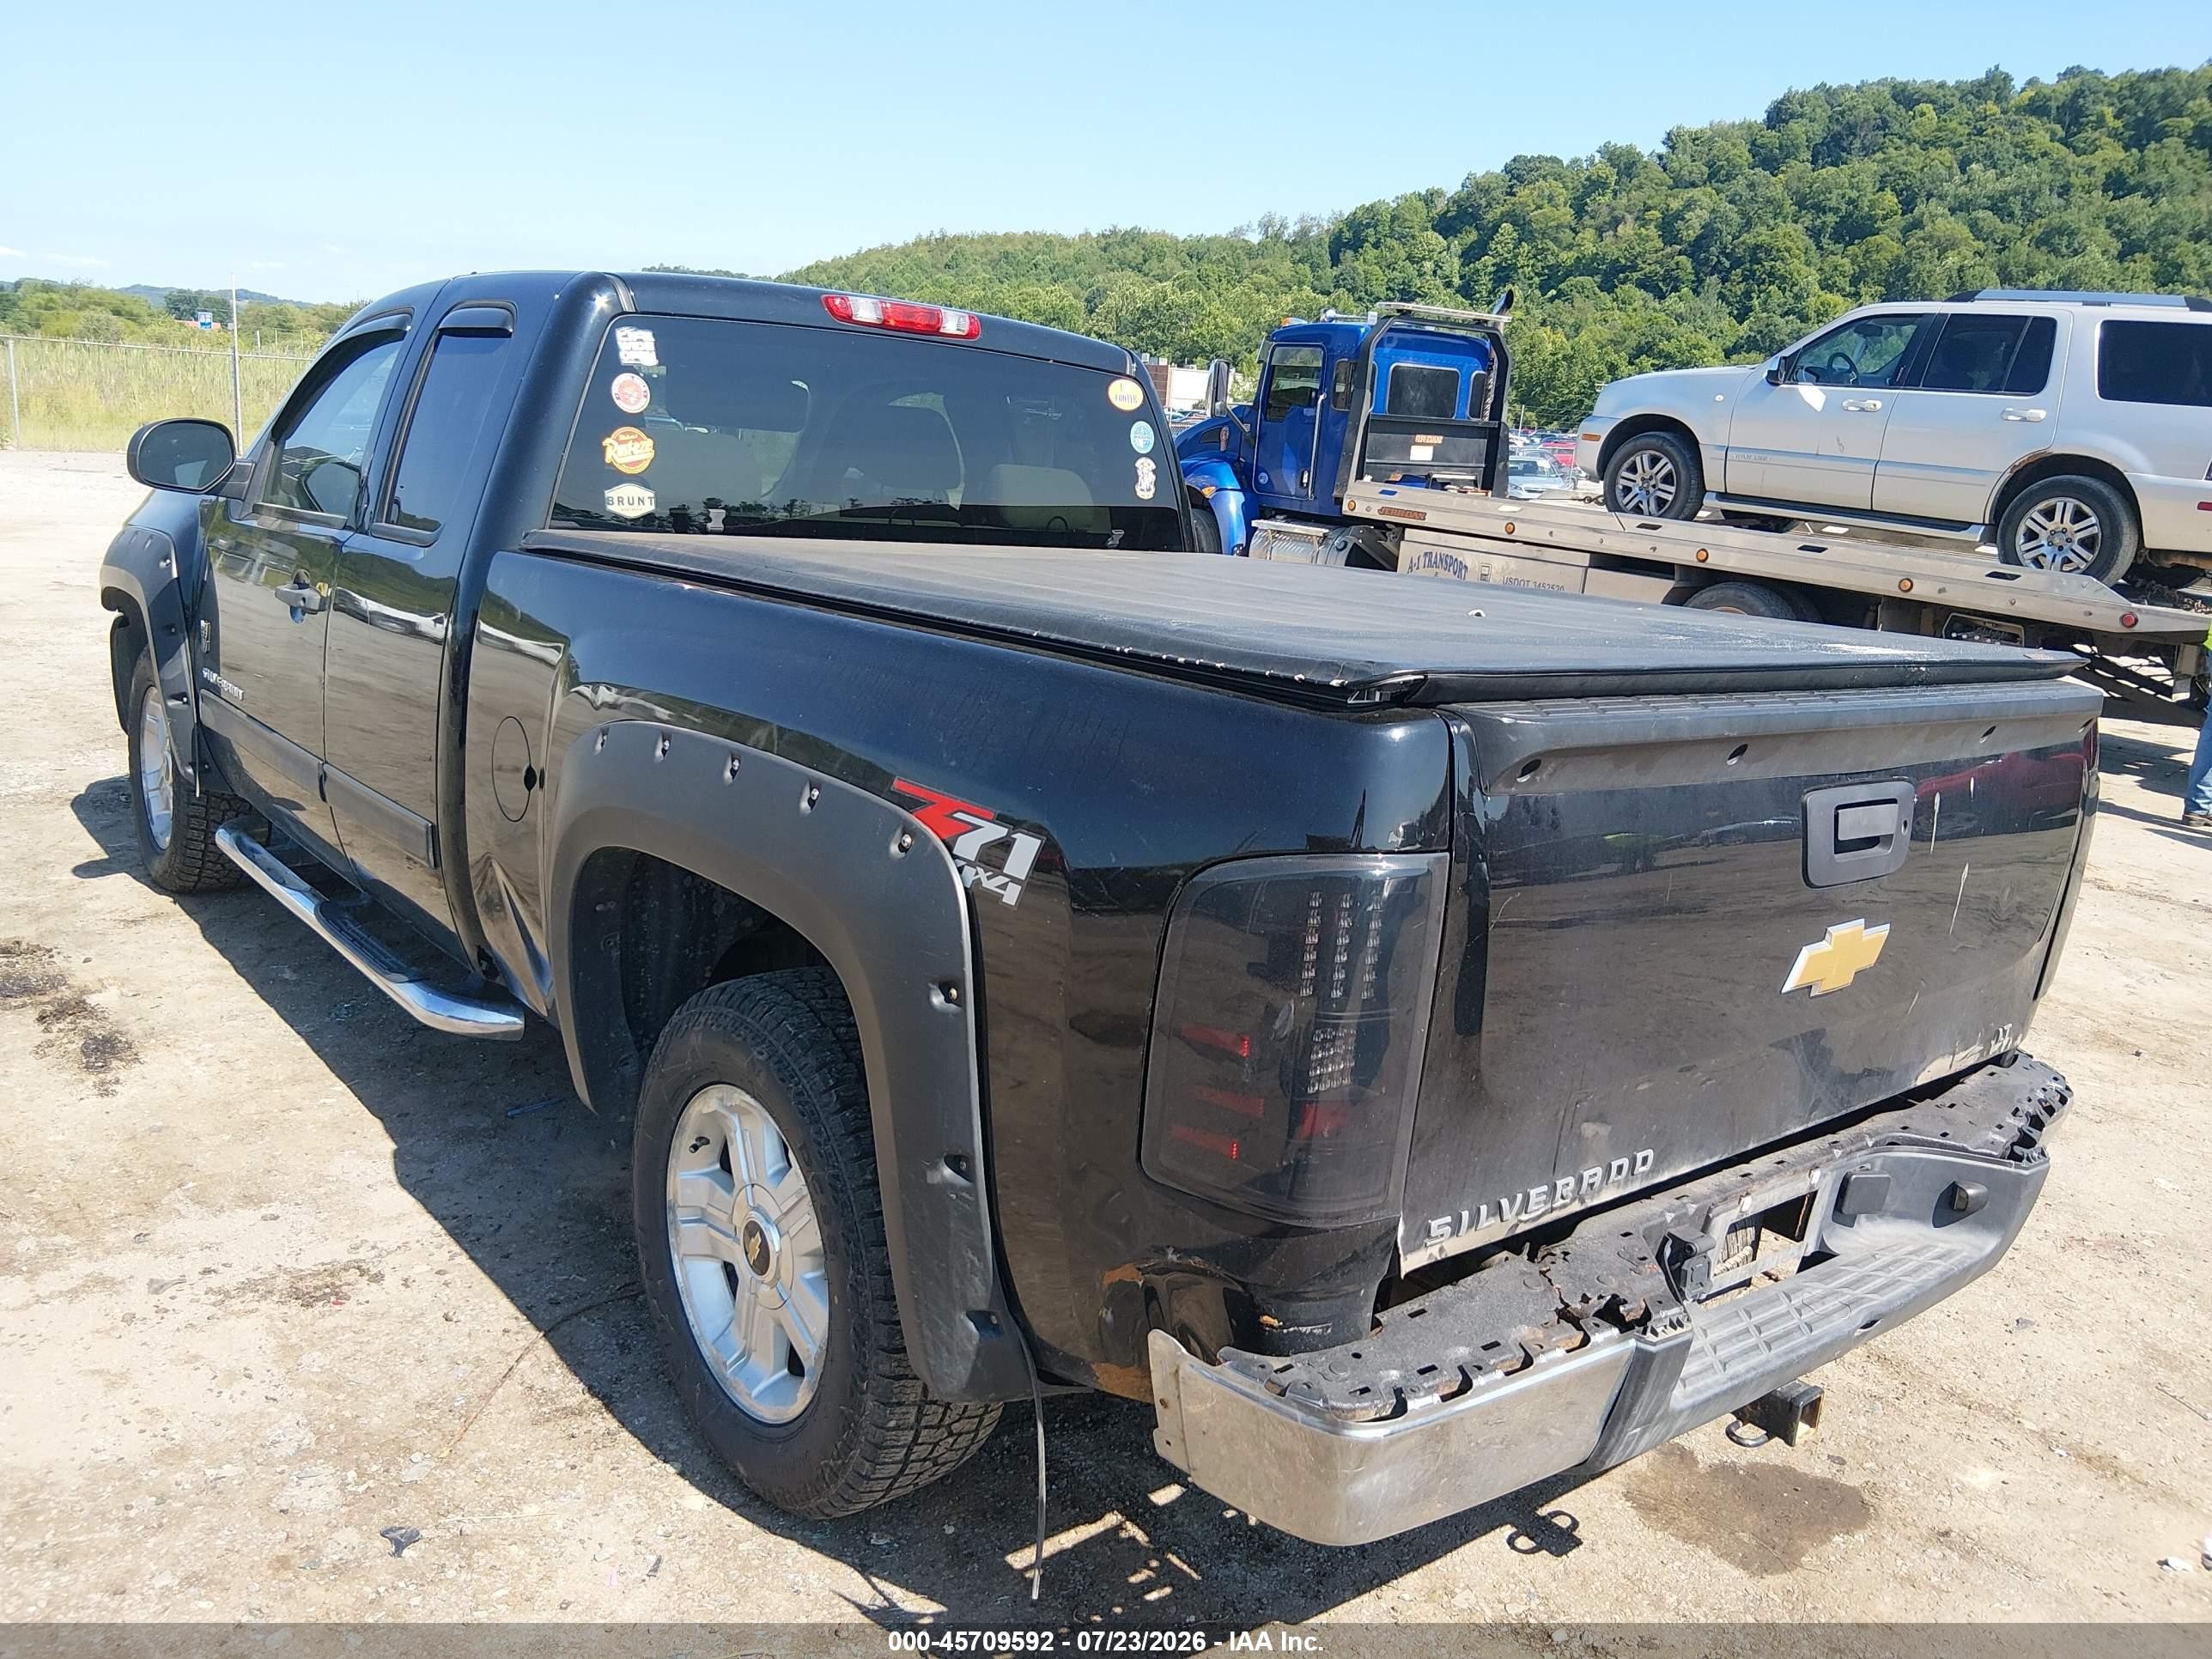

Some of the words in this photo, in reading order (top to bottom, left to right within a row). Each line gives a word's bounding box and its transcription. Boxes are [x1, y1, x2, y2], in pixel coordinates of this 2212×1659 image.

[606, 495, 655, 507] BRUNT
[1422, 550, 1468, 580] TRANSPORT
[1503, 575, 1531, 588] USDOT
[892, 777, 1042, 881] Z71
[1425, 1148, 1654, 1248] SILVERADO
